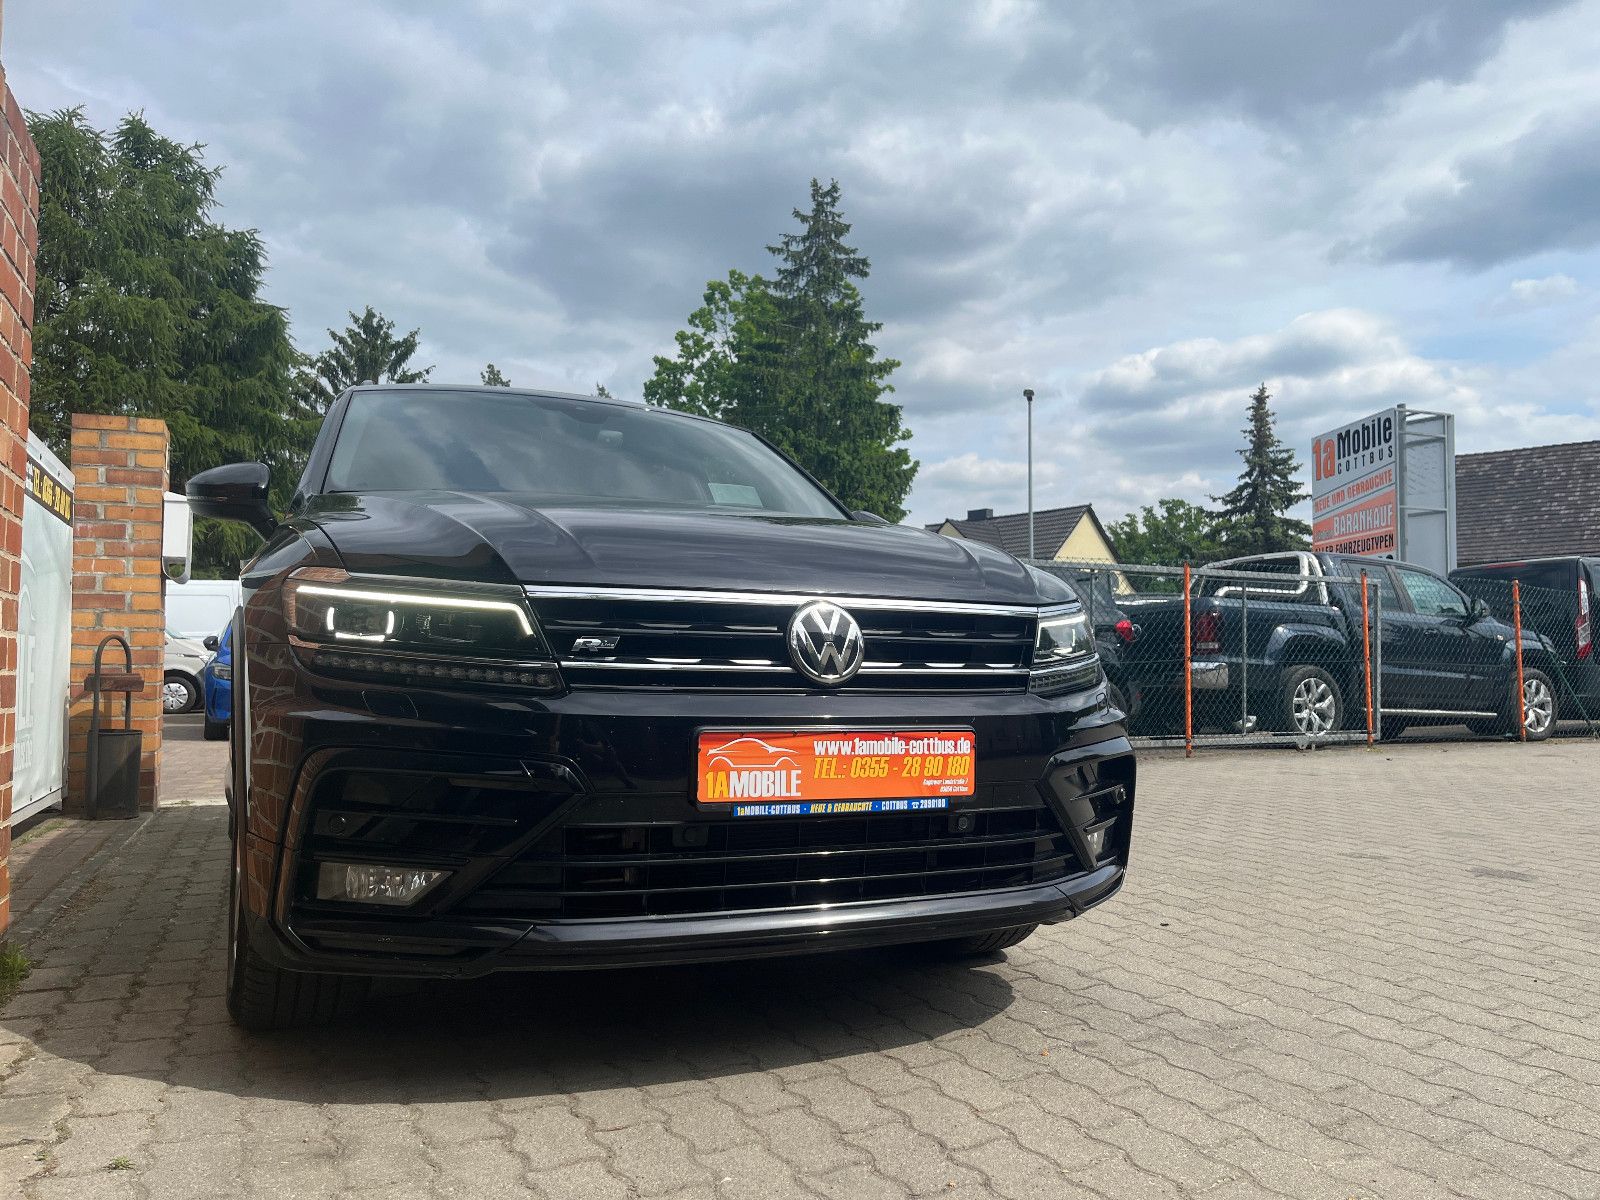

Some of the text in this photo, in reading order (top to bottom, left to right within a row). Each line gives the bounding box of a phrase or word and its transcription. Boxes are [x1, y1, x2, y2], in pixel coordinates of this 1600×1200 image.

[1337, 446, 1393, 475] COTTBUS
[1347, 468, 1393, 500] GEBRAUCHTE
[1333, 504, 1393, 536] BARANKAUF
[814, 737, 971, 756] www.1amobile-cottbus.de
[813, 757, 846, 779] TEL.:
[850, 757, 890, 778] 0355
[902, 756, 922, 777] 28
[924, 756, 943, 777] 90
[946, 755, 971, 776] 180
[706, 769, 802, 799] 1AMOBILE
[810, 803, 826, 814] NEUE
[833, 801, 873, 812] GEBRAUCHTE
[882, 800, 908, 811] COTTBUS
